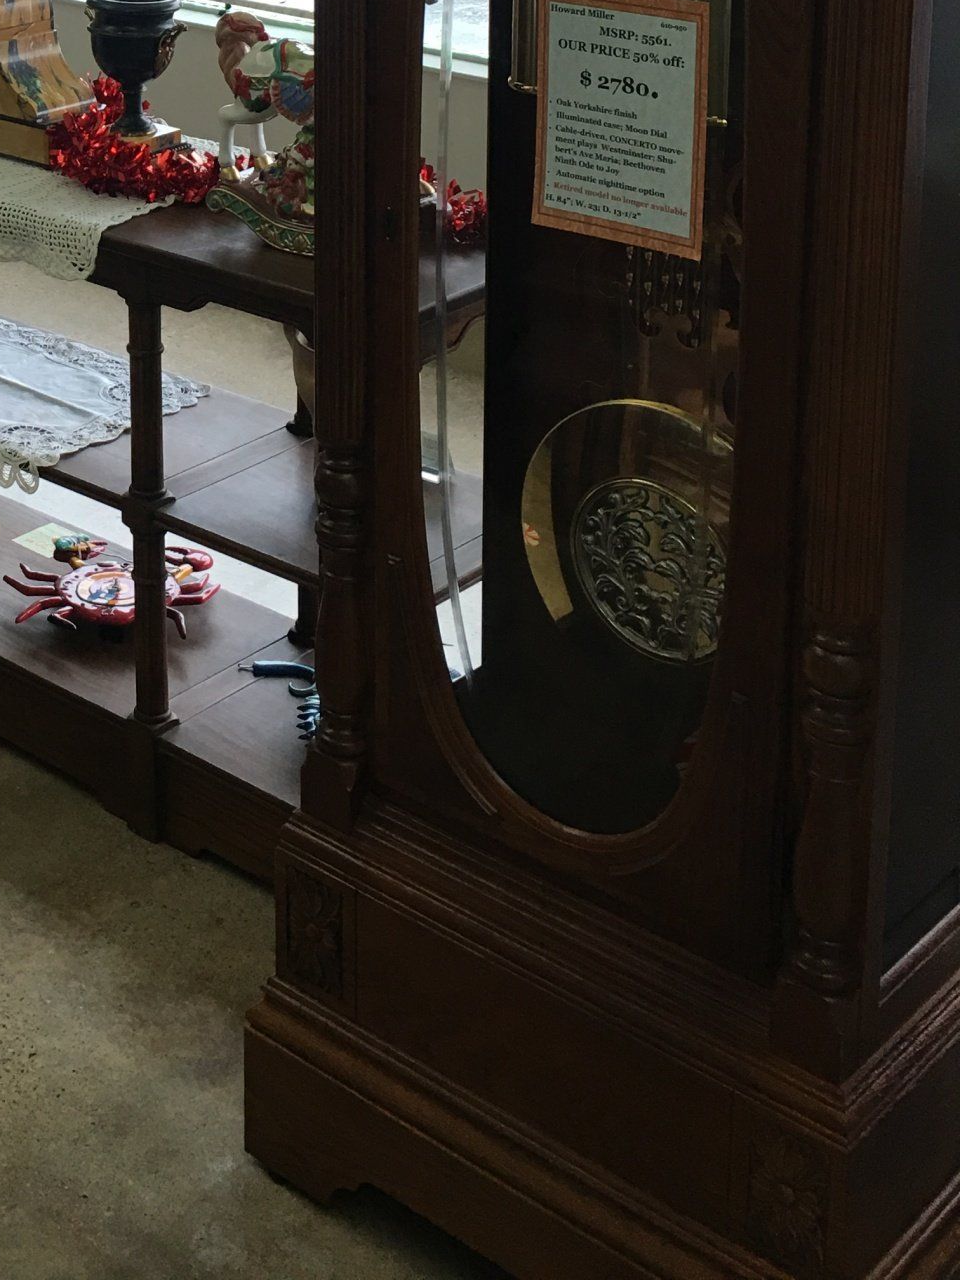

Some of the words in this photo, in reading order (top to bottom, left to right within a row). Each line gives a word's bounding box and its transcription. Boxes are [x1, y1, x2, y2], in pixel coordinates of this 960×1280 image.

[551, 4, 586, 16] Howard
[588, 9, 615, 20] Miller
[599, 26, 639, 42] MSRP:
[641, 34, 672, 46] 5561.
[660, 22, 688, 32] 610-950
[558, 38, 588, 52] OUR
[590, 43, 630, 59] PRICE
[633, 52, 660, 64] 50%
[662, 56, 685, 68] off:
[580, 68, 592, 88] $
[597, 75, 659, 99] 2780.
[556, 98, 572, 108] Oak
[574, 100, 613, 115] Yorkshire
[614, 108, 638, 119] finish
[556, 111, 602, 126] Illuminated
[625, 124, 649, 135] Moon
[650, 129, 668, 139] Dial
[555, 136, 576, 145] ment
[577, 139, 598, 150] plays
[657, 155, 676, 165] Shu-
[609, 135, 658, 150] CONCERTO
[658, 146, 685, 156] move-
[554, 156, 578, 166] Ninth
[578, 160, 595, 170] Ode
[605, 165, 620, 176] Joy
[579, 149, 594, 158] Ave
[623, 159, 666, 174] Beethoven
[556, 169, 597, 184] Automatic
[598, 176, 637, 192] nighttime
[638, 186, 665, 198] option
[545, 194, 555, 202] H.
[575, 199, 586, 208] W.
[602, 204, 612, 213] D.
[553, 182, 583, 194] Retired
[584, 188, 609, 199] model
[611, 194, 622, 202] no
[622, 196, 650, 209] longer
[651, 203, 688, 217] available
